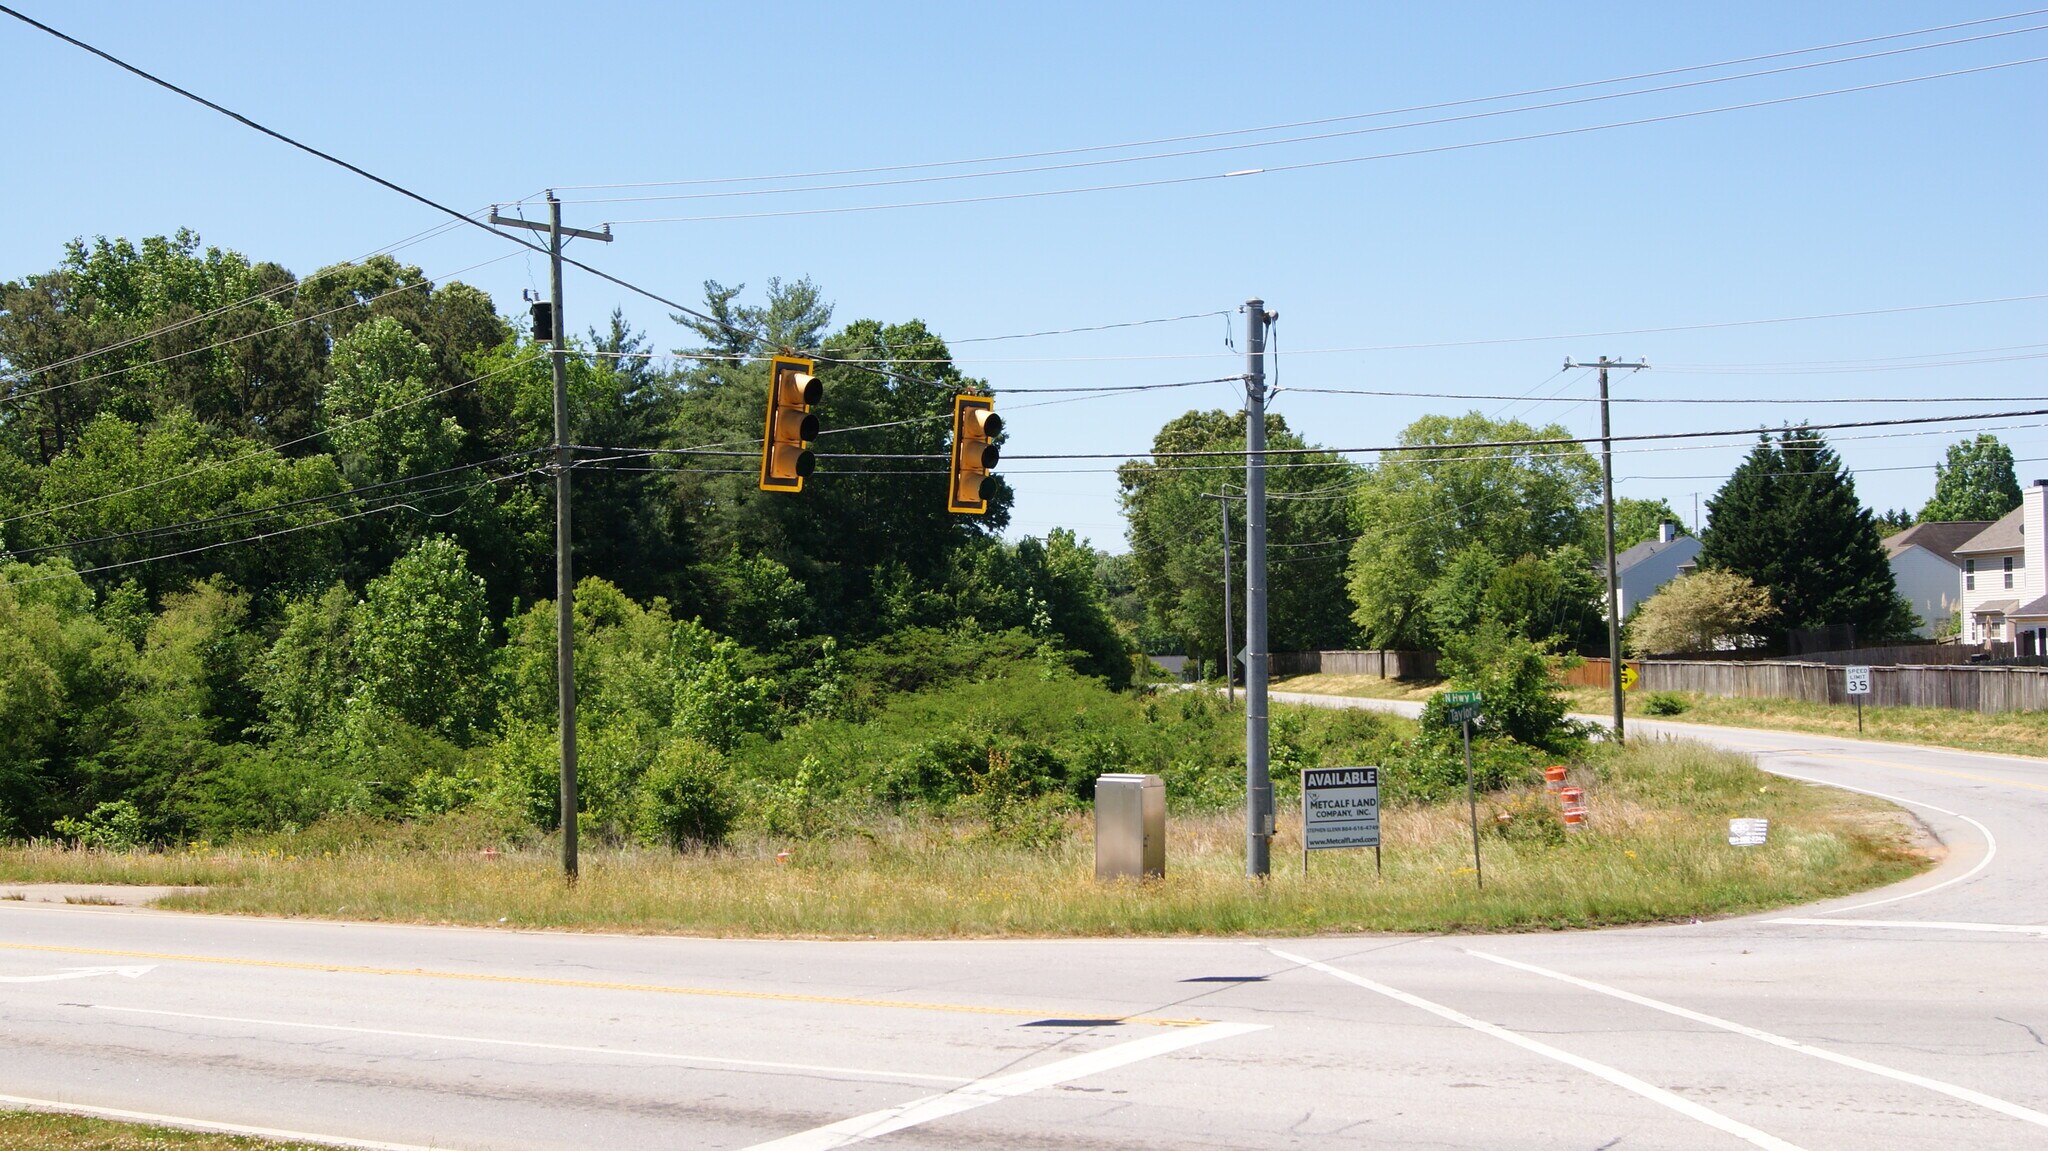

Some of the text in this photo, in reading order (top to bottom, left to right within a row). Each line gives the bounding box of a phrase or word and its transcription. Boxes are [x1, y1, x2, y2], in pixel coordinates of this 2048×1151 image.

[1849, 681, 1868, 691] 35
[1445, 692, 1482, 703] N Hwy 14
[1450, 706, 1472, 721] Taylor
[1308, 771, 1375, 786] AVAILABLE
[1310, 798, 1376, 809] METCALF LAND
